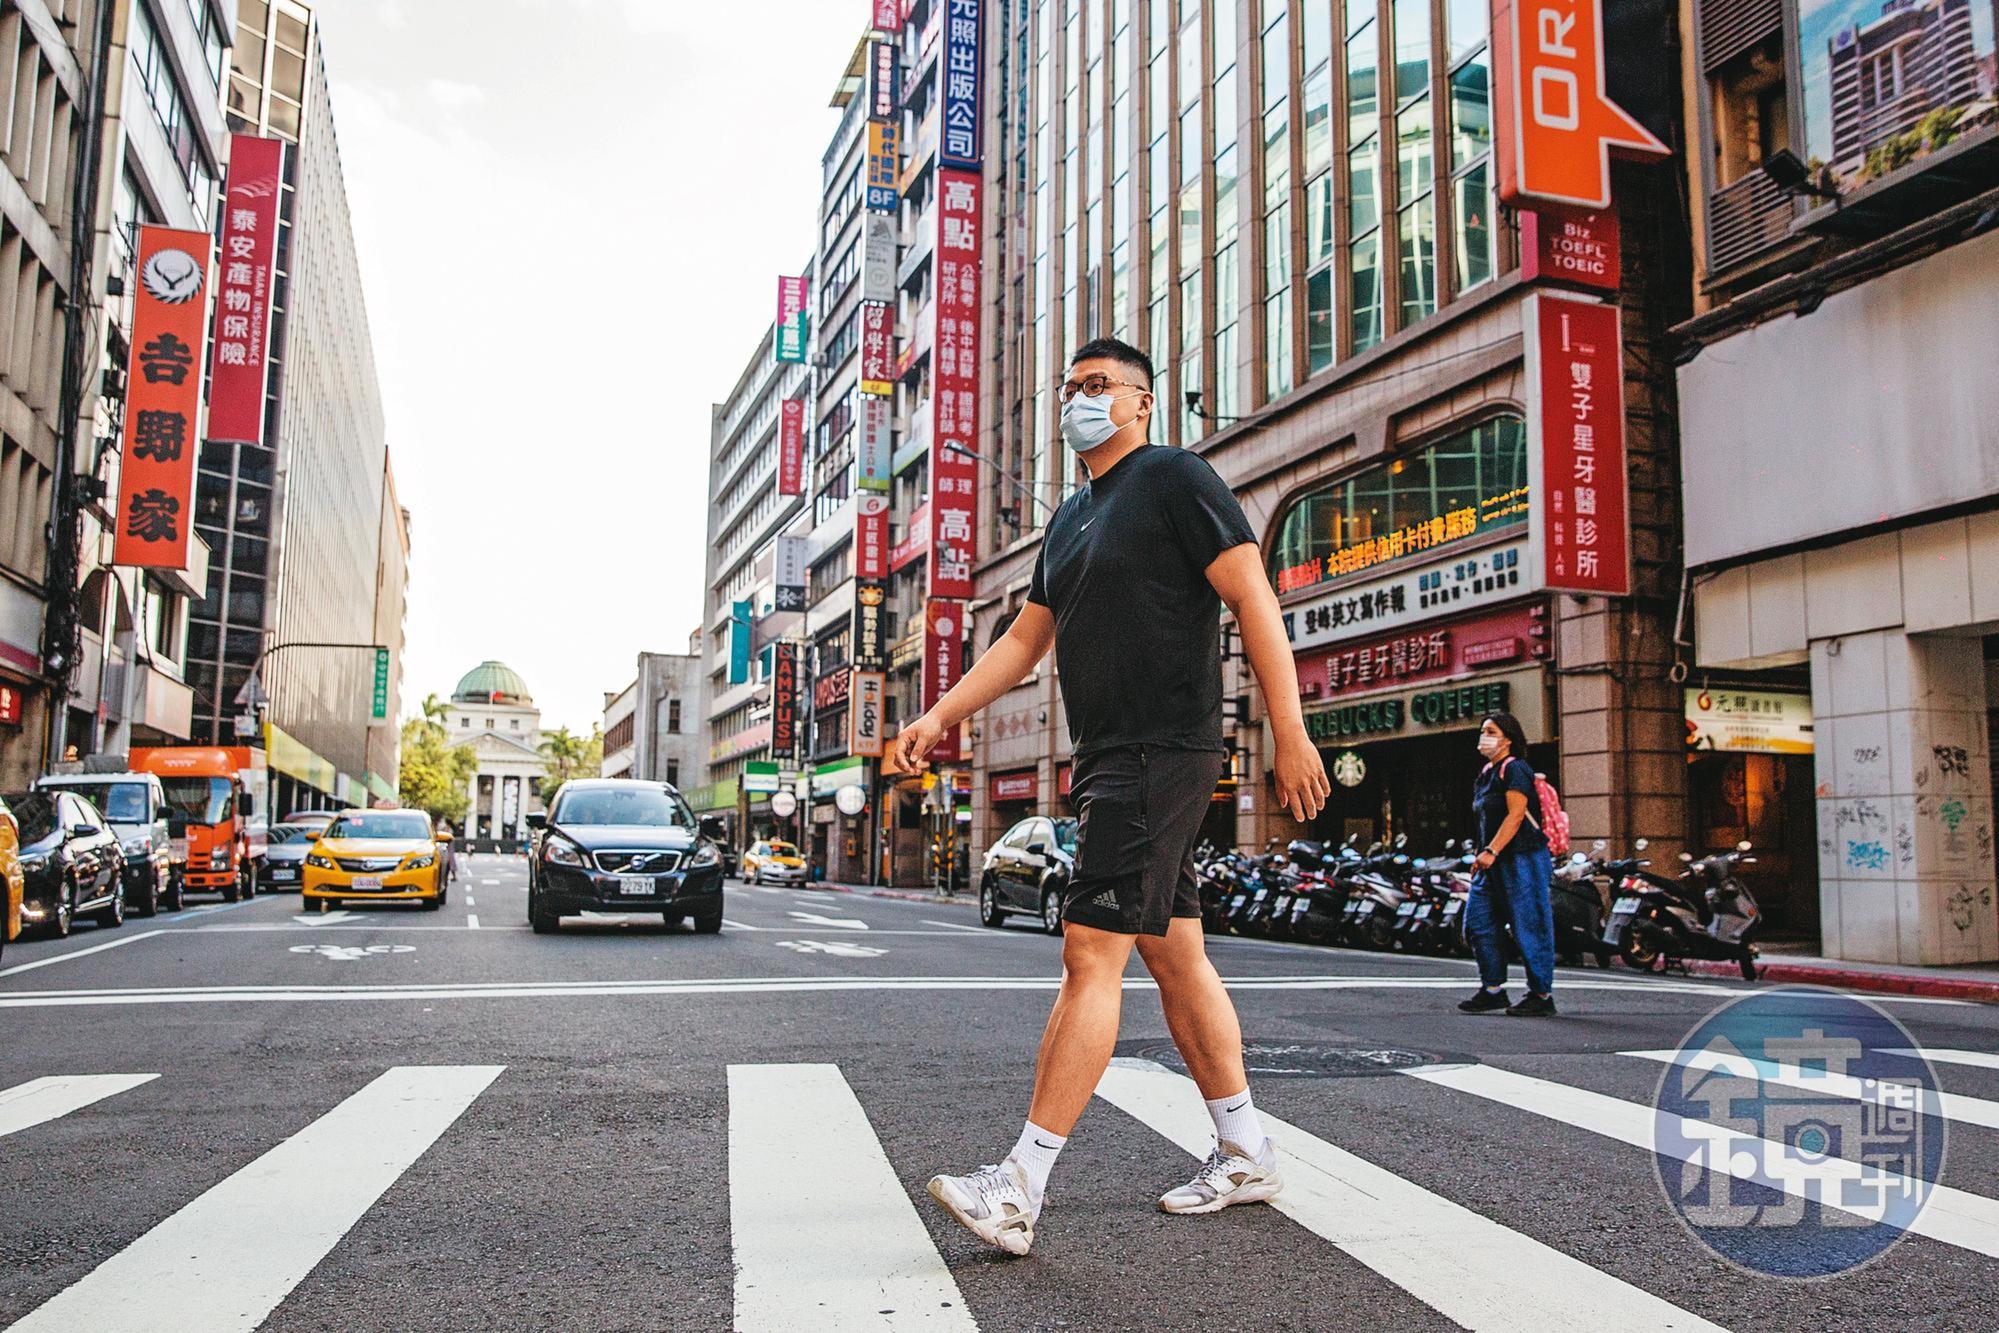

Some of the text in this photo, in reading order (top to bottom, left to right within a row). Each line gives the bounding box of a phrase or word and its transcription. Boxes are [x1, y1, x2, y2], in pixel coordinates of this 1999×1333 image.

[1533, 0, 1579, 132] OR
[868, 189, 894, 207] 8F
[943, 180, 976, 251] 高點
[1552, 237, 1607, 260] TOEFL
[1564, 222, 1592, 240] Biz
[219, 207, 258, 366] 泰安產物保險
[1552, 253, 1605, 276] TOEIC
[1570, 361, 1599, 579] 雙子星牙醫診所
[1326, 630, 1449, 689] 雙子星牙醫診所
[776, 645, 793, 739] CAMPUS
[859, 680, 878, 738] Holiday
[1411, 682, 1509, 724] COFFEE
[1092, 897, 1120, 910] adidas
